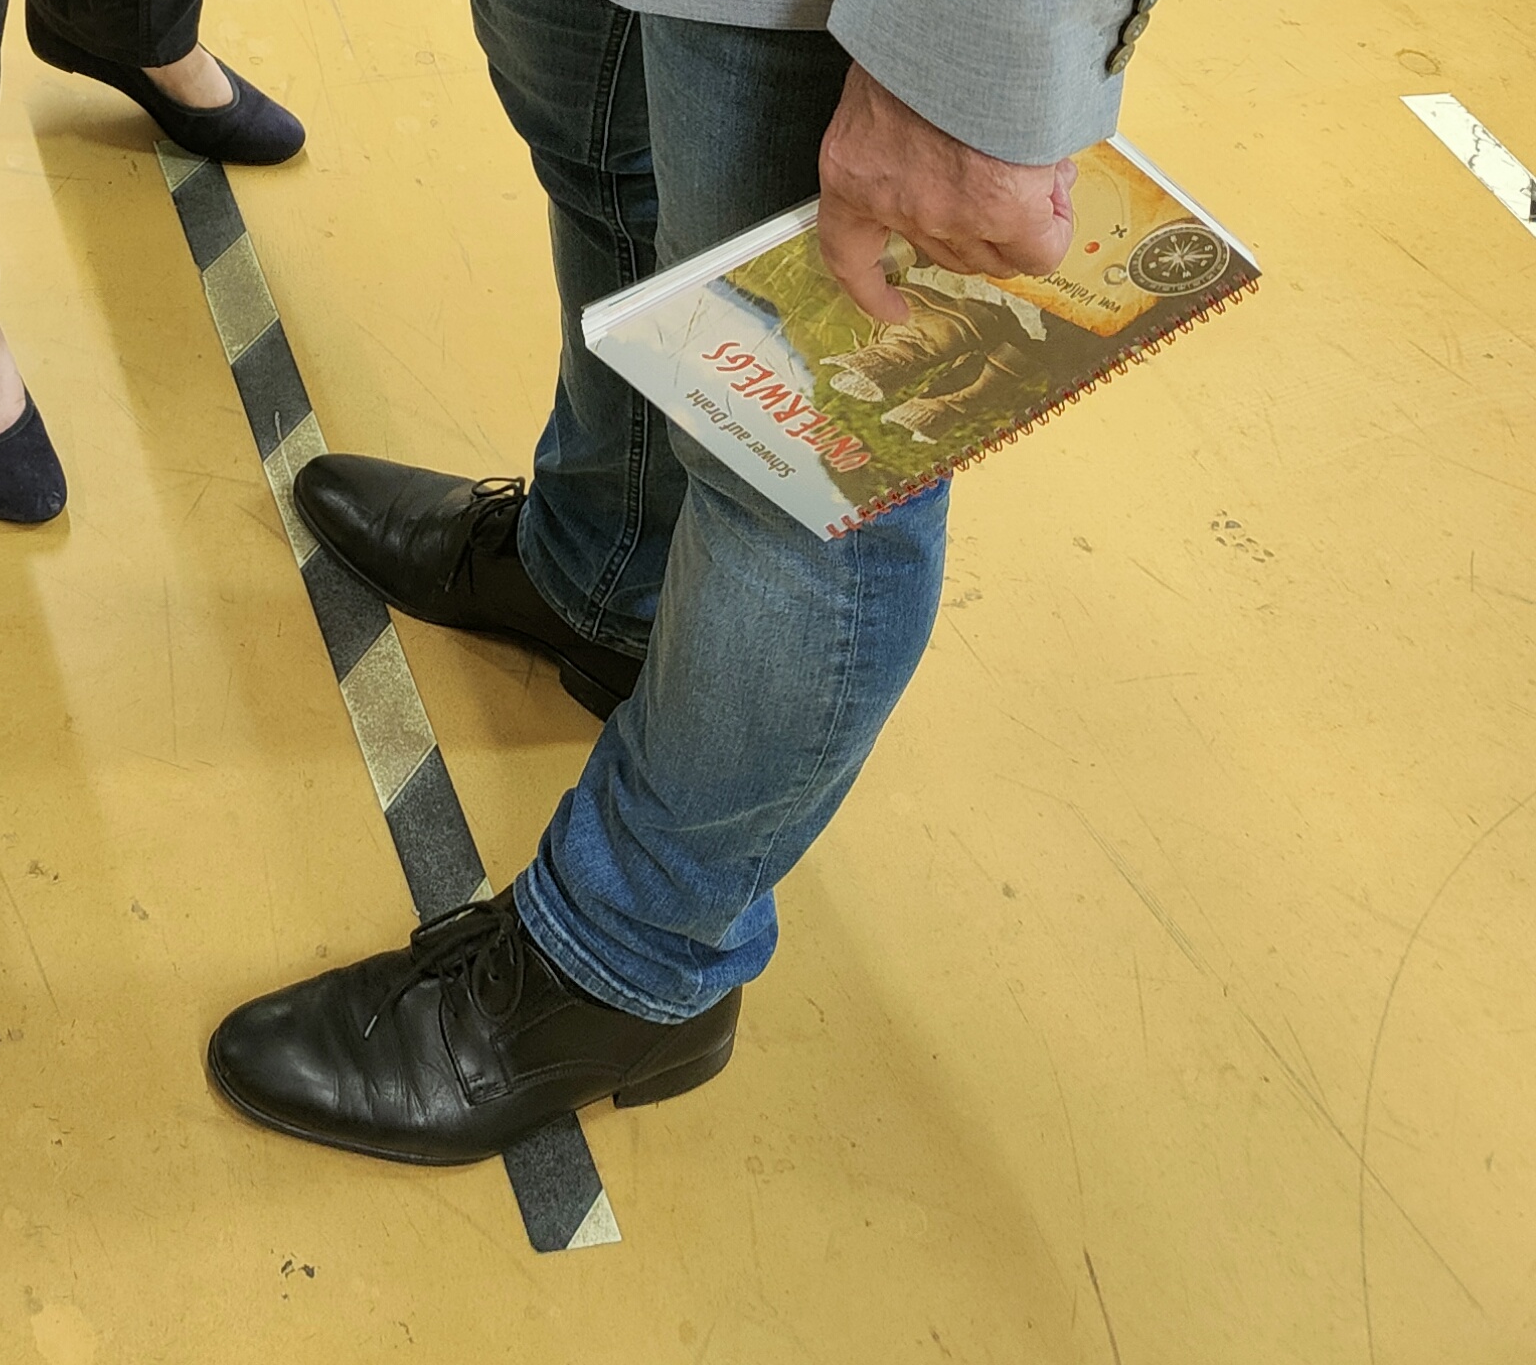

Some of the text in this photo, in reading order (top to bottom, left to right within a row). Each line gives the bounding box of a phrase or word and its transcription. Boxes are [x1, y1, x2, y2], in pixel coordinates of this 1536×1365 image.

[1097, 296, 1122, 313] von
[685, 388, 797, 479] Schwer auf Draht
[701, 342, 872, 473] UNTERWEGS
